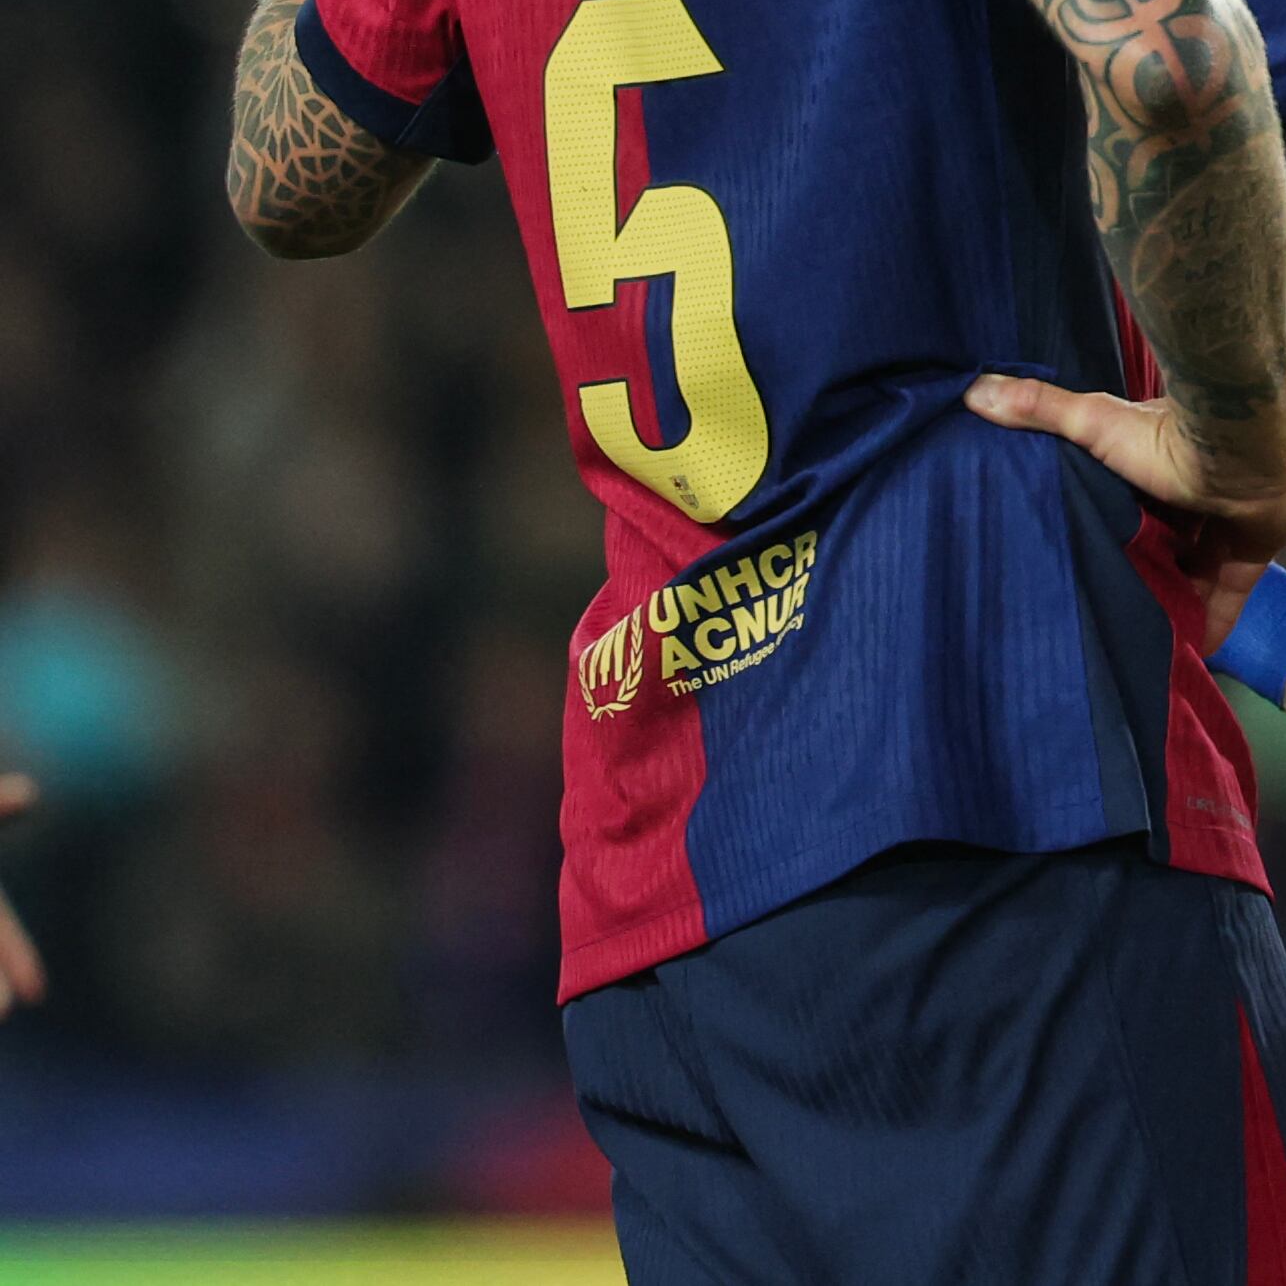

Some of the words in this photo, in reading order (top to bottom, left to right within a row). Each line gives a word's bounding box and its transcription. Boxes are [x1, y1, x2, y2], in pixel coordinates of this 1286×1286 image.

[649, 530, 817, 633] UNHCR
[661, 572, 810, 680] ACNUR
[667, 676, 703, 697] The
[703, 663, 730, 685] UN
[729, 642, 775, 677] Refugee
